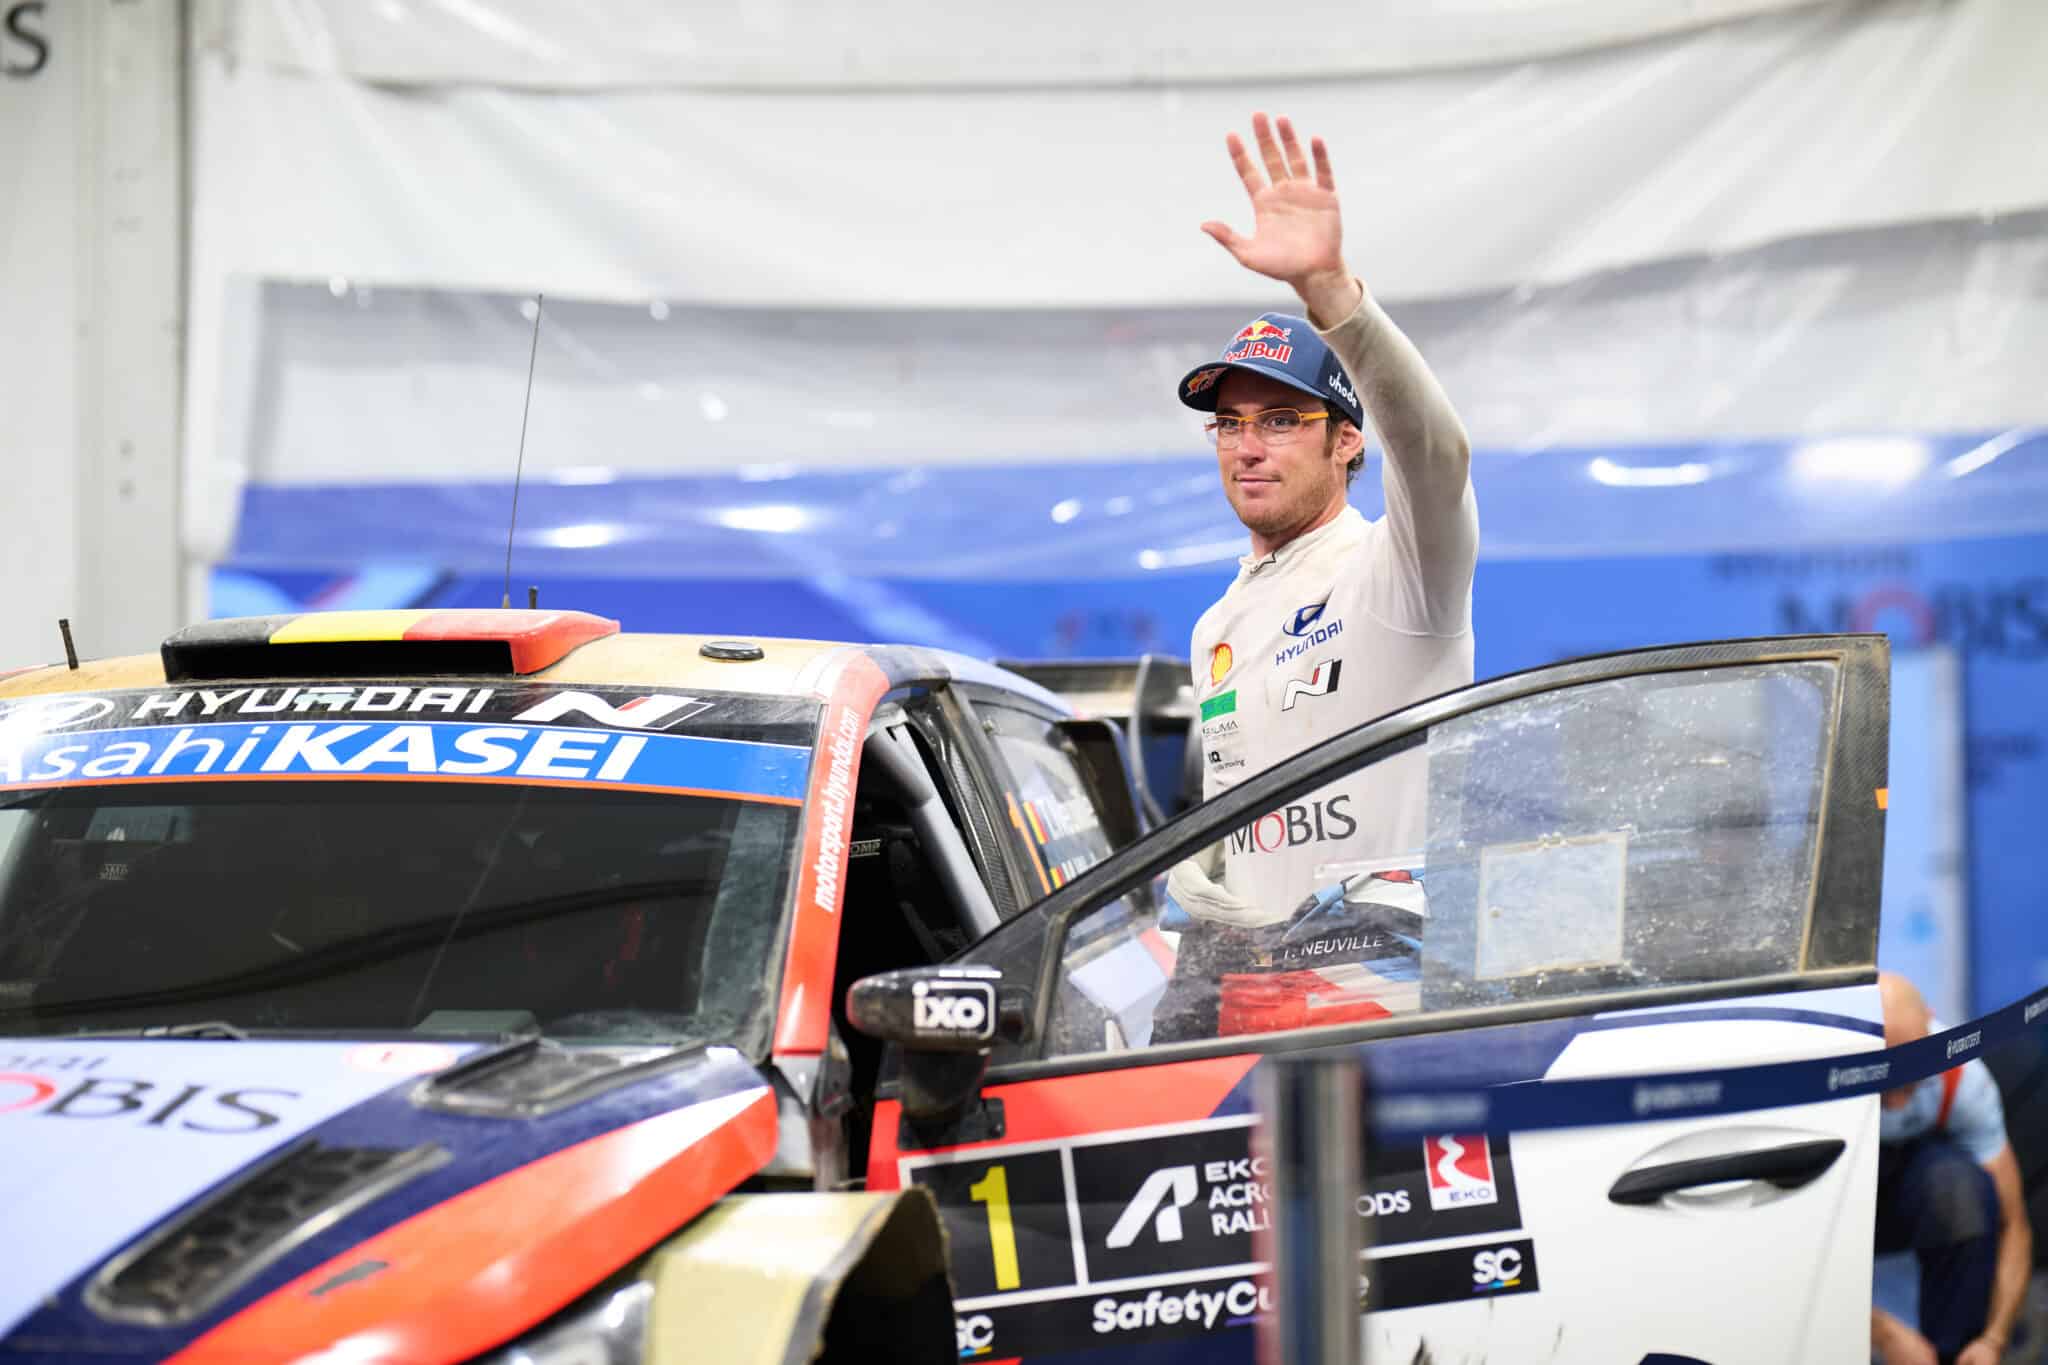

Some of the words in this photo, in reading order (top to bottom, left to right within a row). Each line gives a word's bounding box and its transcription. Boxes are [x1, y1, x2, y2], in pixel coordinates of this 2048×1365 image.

[1251, 341, 1293, 364] Bull
[1275, 619, 1344, 666] HYUNDAI
[1231, 795, 1357, 855] MOBIS
[1301, 935, 1385, 956] NEUVILLE
[1356, 1189, 1411, 1217] ODS
[1450, 1186, 1490, 1201] EKO
[970, 1166, 1020, 1290] 1
[1472, 1247, 1522, 1284] SC
